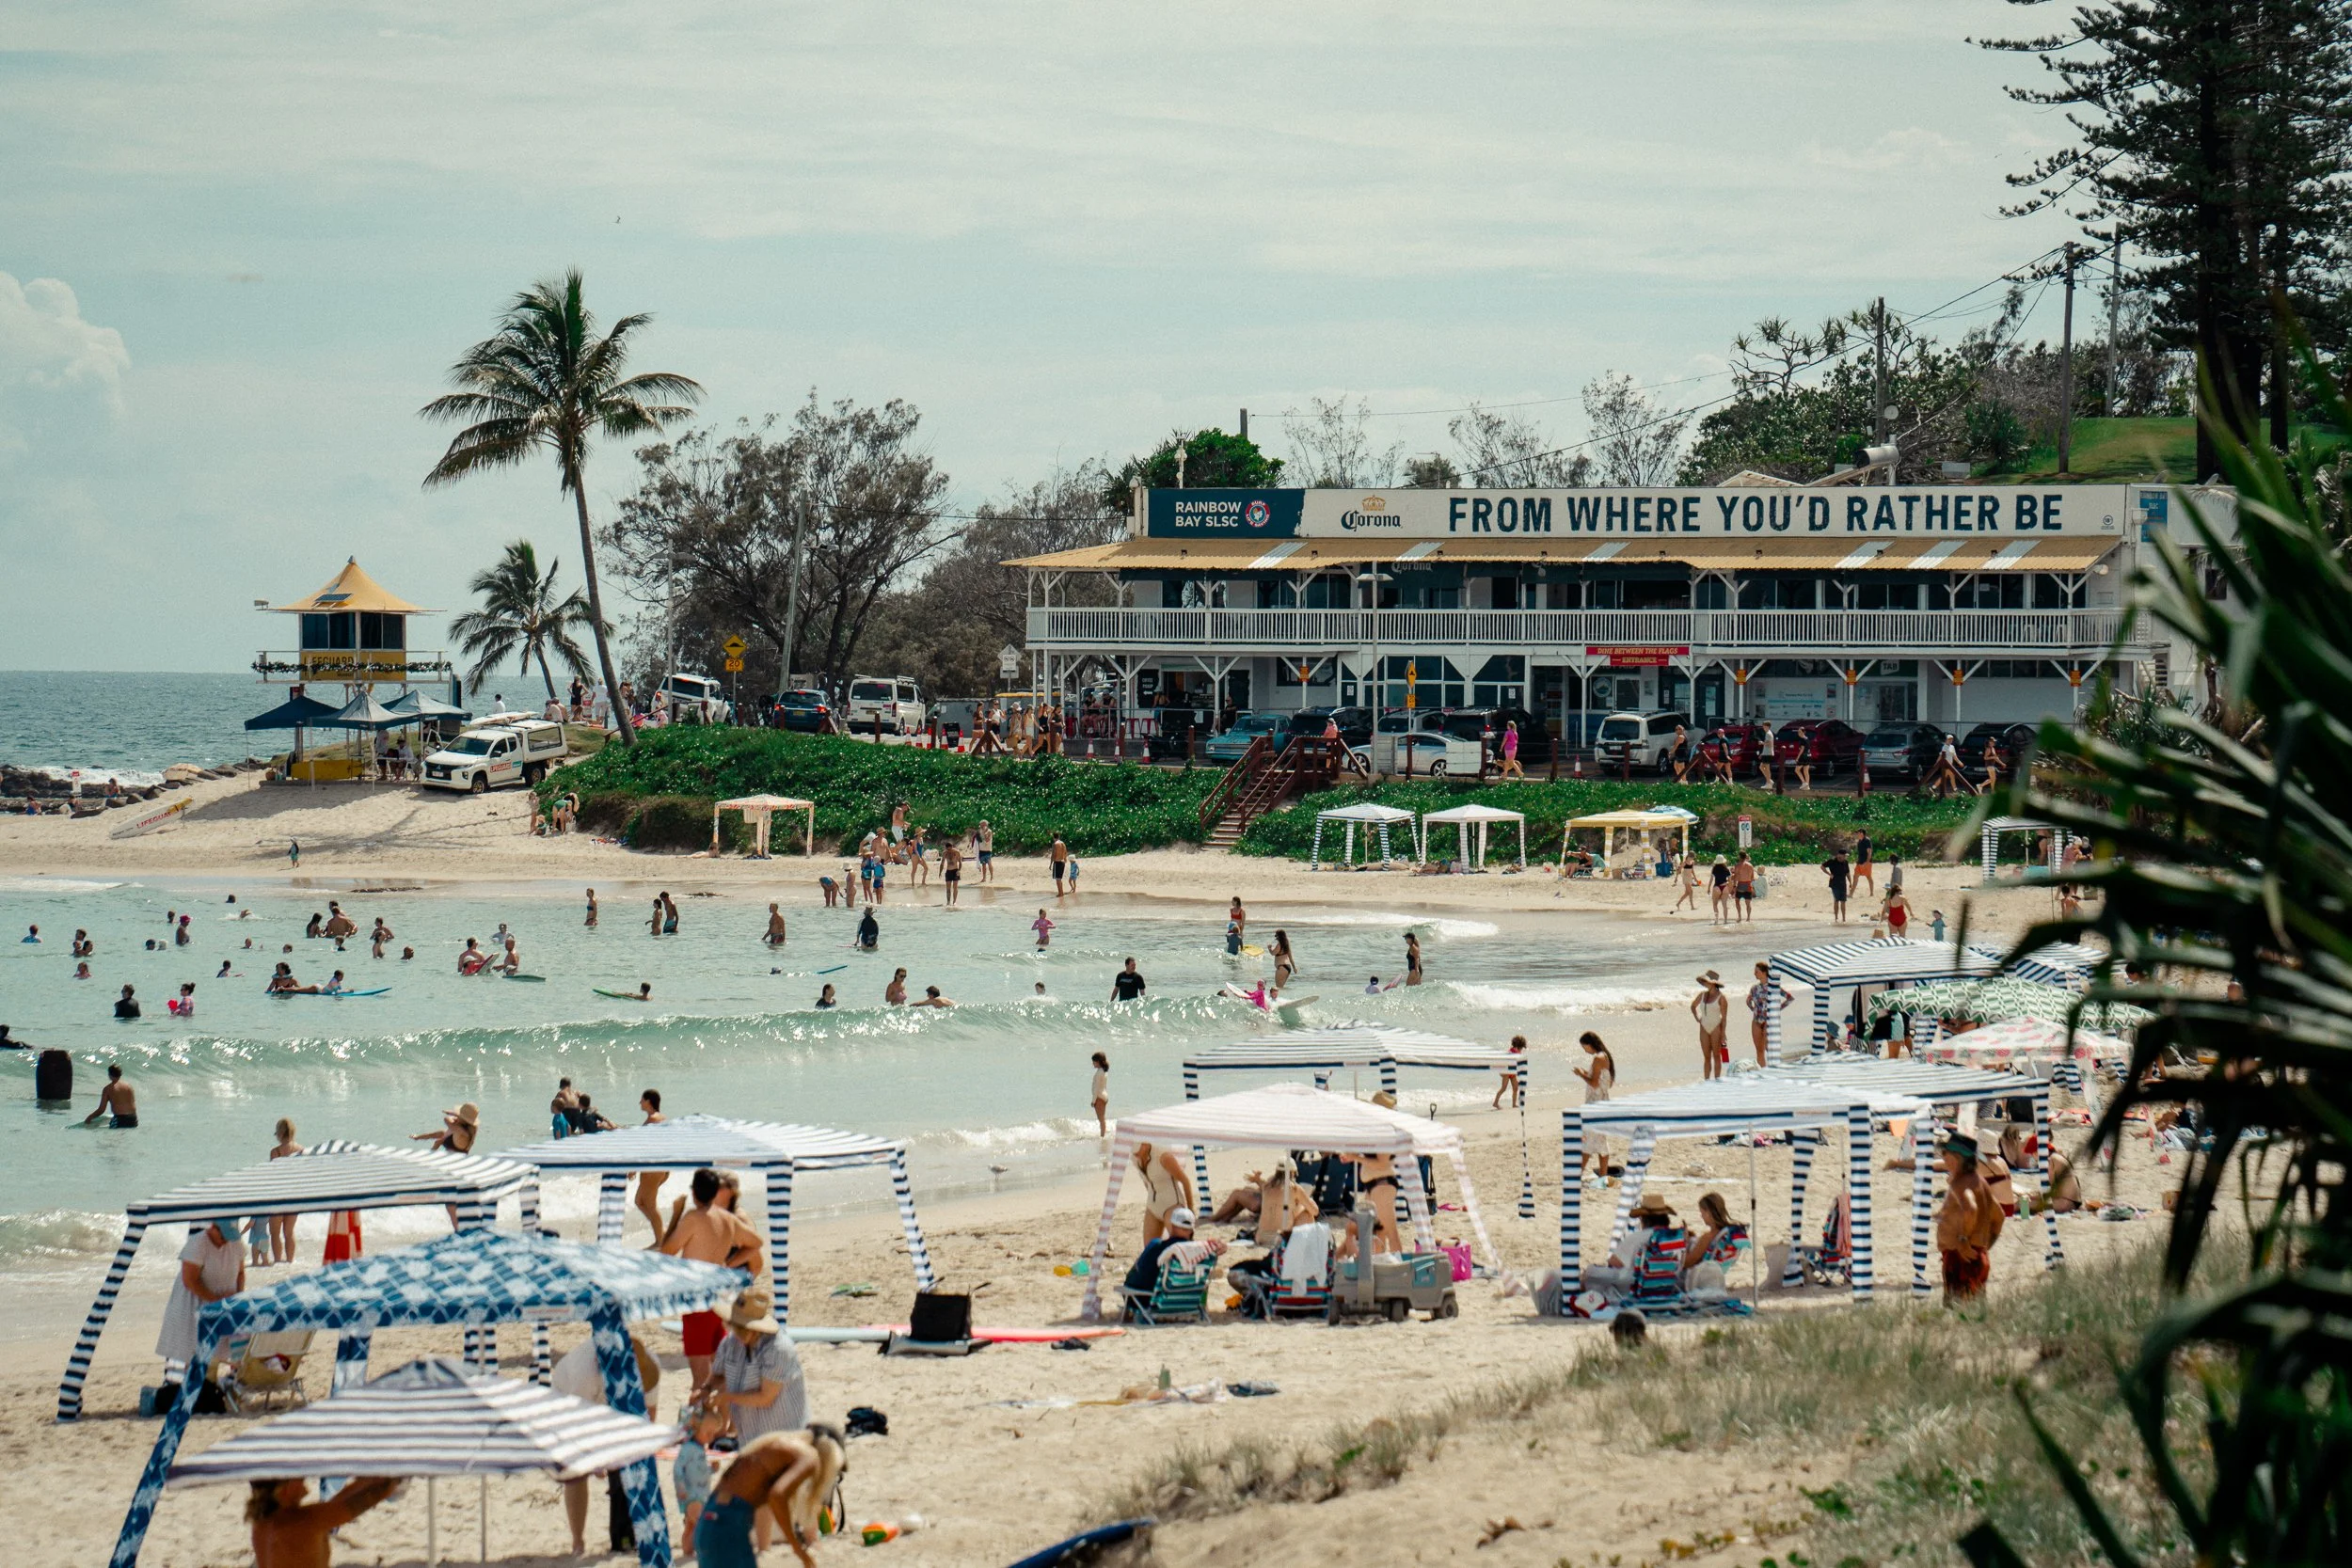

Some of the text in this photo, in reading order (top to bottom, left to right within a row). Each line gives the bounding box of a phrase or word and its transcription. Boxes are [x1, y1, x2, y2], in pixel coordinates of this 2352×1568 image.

[1175, 501, 1242, 514] RAINBOW
[1449, 494, 2063, 532] FROM WHERE YOU'D RATHER BE
[1175, 515, 1238, 528] BAY SLSC
[1341, 509, 1402, 532] Corona
